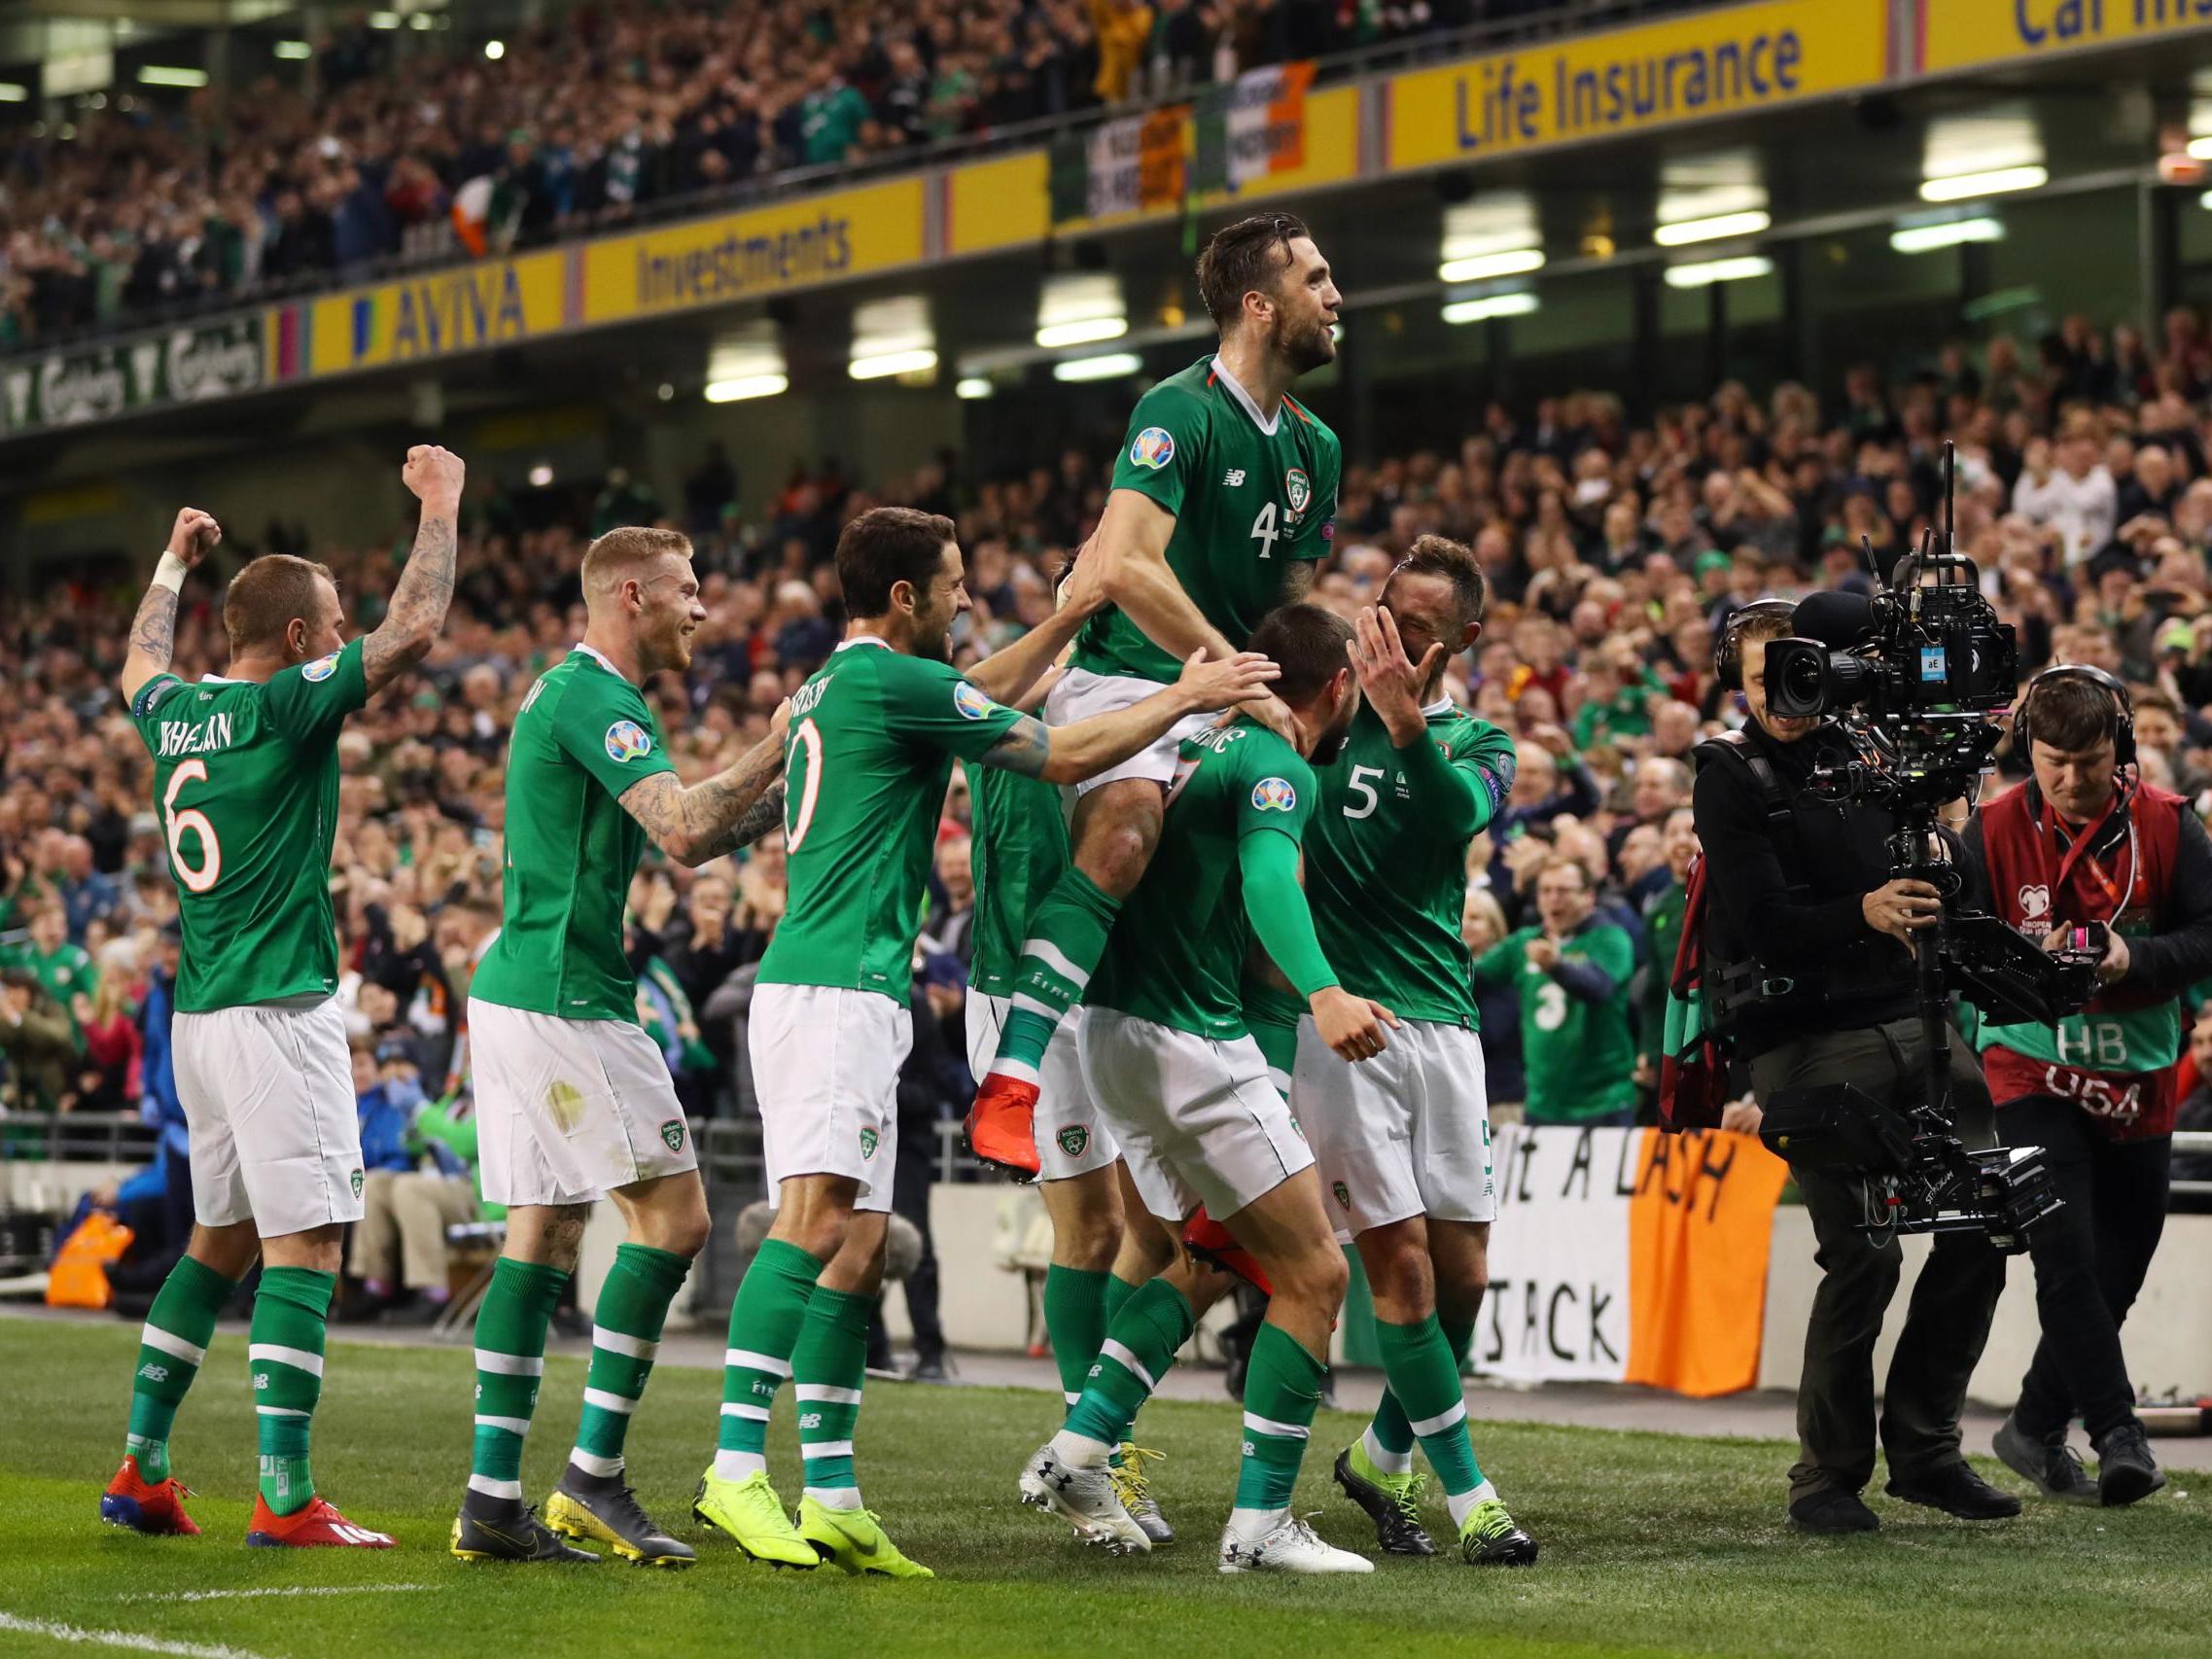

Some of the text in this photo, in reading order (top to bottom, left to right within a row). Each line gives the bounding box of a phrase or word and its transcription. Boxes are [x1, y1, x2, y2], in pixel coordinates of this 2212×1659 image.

[1456, 30, 1801, 149] Life Insurance
[638, 215, 852, 301] Investments
[392, 265, 528, 358] AVIVA
[1250, 501, 1280, 559] 4
[157, 712, 233, 757] WHELAN
[163, 759, 222, 892] 6
[1343, 763, 1385, 819] 5
[1534, 980, 1566, 1031] 3
[2056, 1023, 2127, 1066] HB
[2045, 1065, 2140, 1126] U54
[1562, 1126, 1593, 1201] A
[1615, 1128, 1737, 1223] LASH
[1486, 1280, 1619, 1363] JACK
